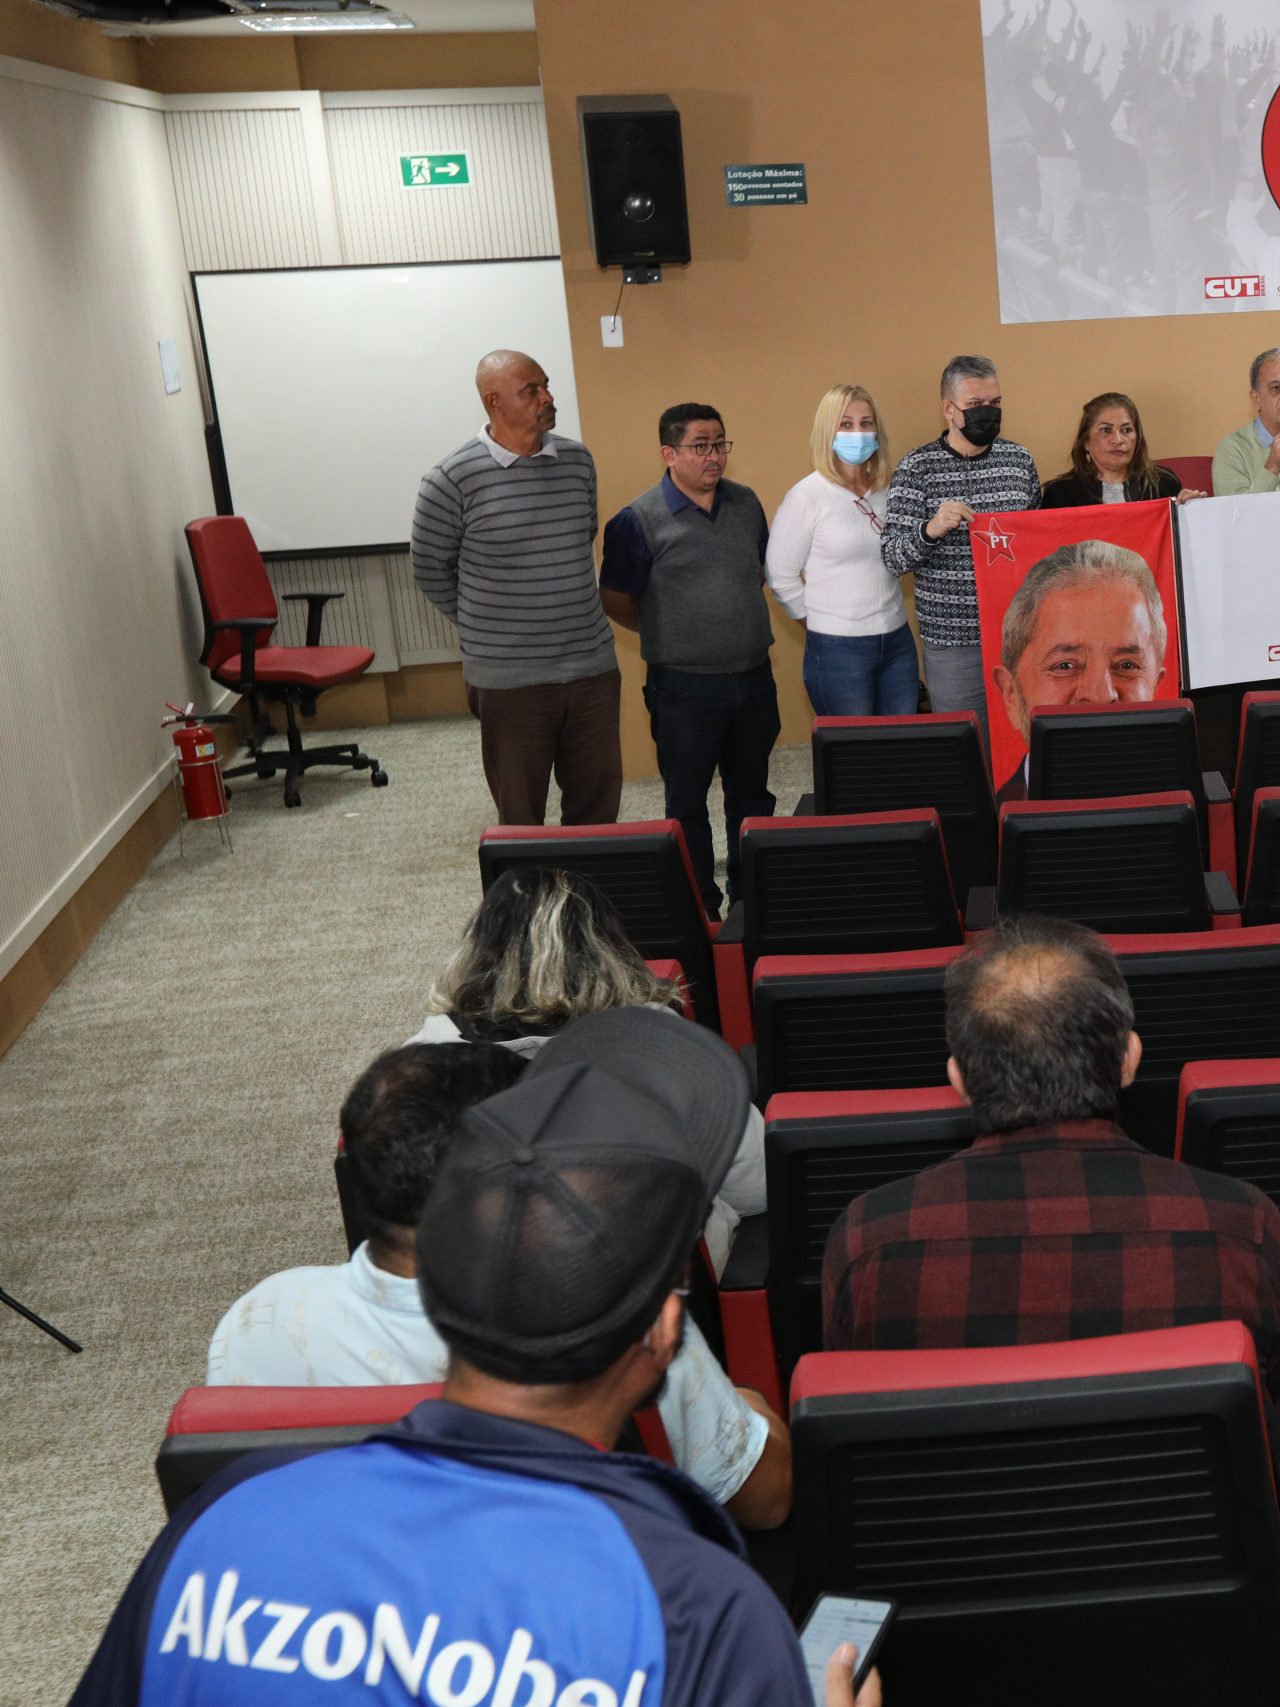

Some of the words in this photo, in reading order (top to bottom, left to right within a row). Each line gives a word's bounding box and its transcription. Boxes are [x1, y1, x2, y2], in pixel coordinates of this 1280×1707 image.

[727, 170, 763, 179] Lotação
[765, 169, 803, 177] Máxima:
[733, 193, 745, 202] 30
[1205, 278, 1259, 298] CUT
[990, 535, 1008, 549] PT
